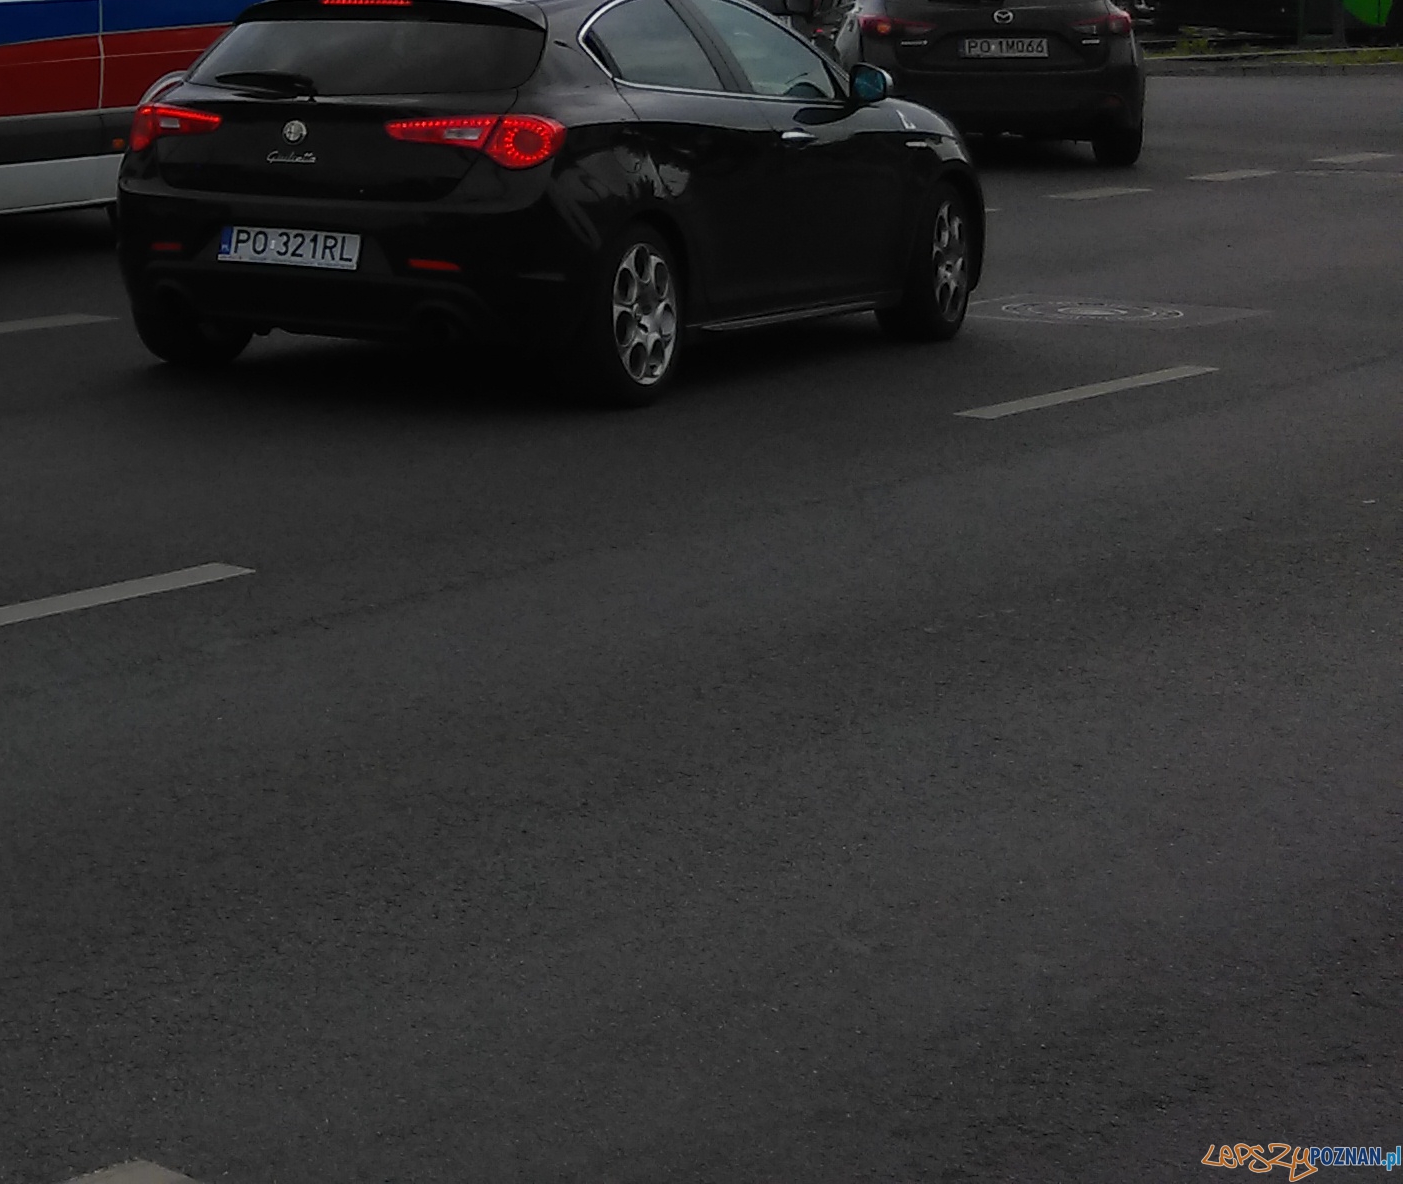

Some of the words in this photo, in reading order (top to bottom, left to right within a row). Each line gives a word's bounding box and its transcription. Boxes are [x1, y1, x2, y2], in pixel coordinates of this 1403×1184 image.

[967, 39, 991, 54] PO
[234, 229, 269, 255] PO
[276, 232, 353, 263] 321RL
